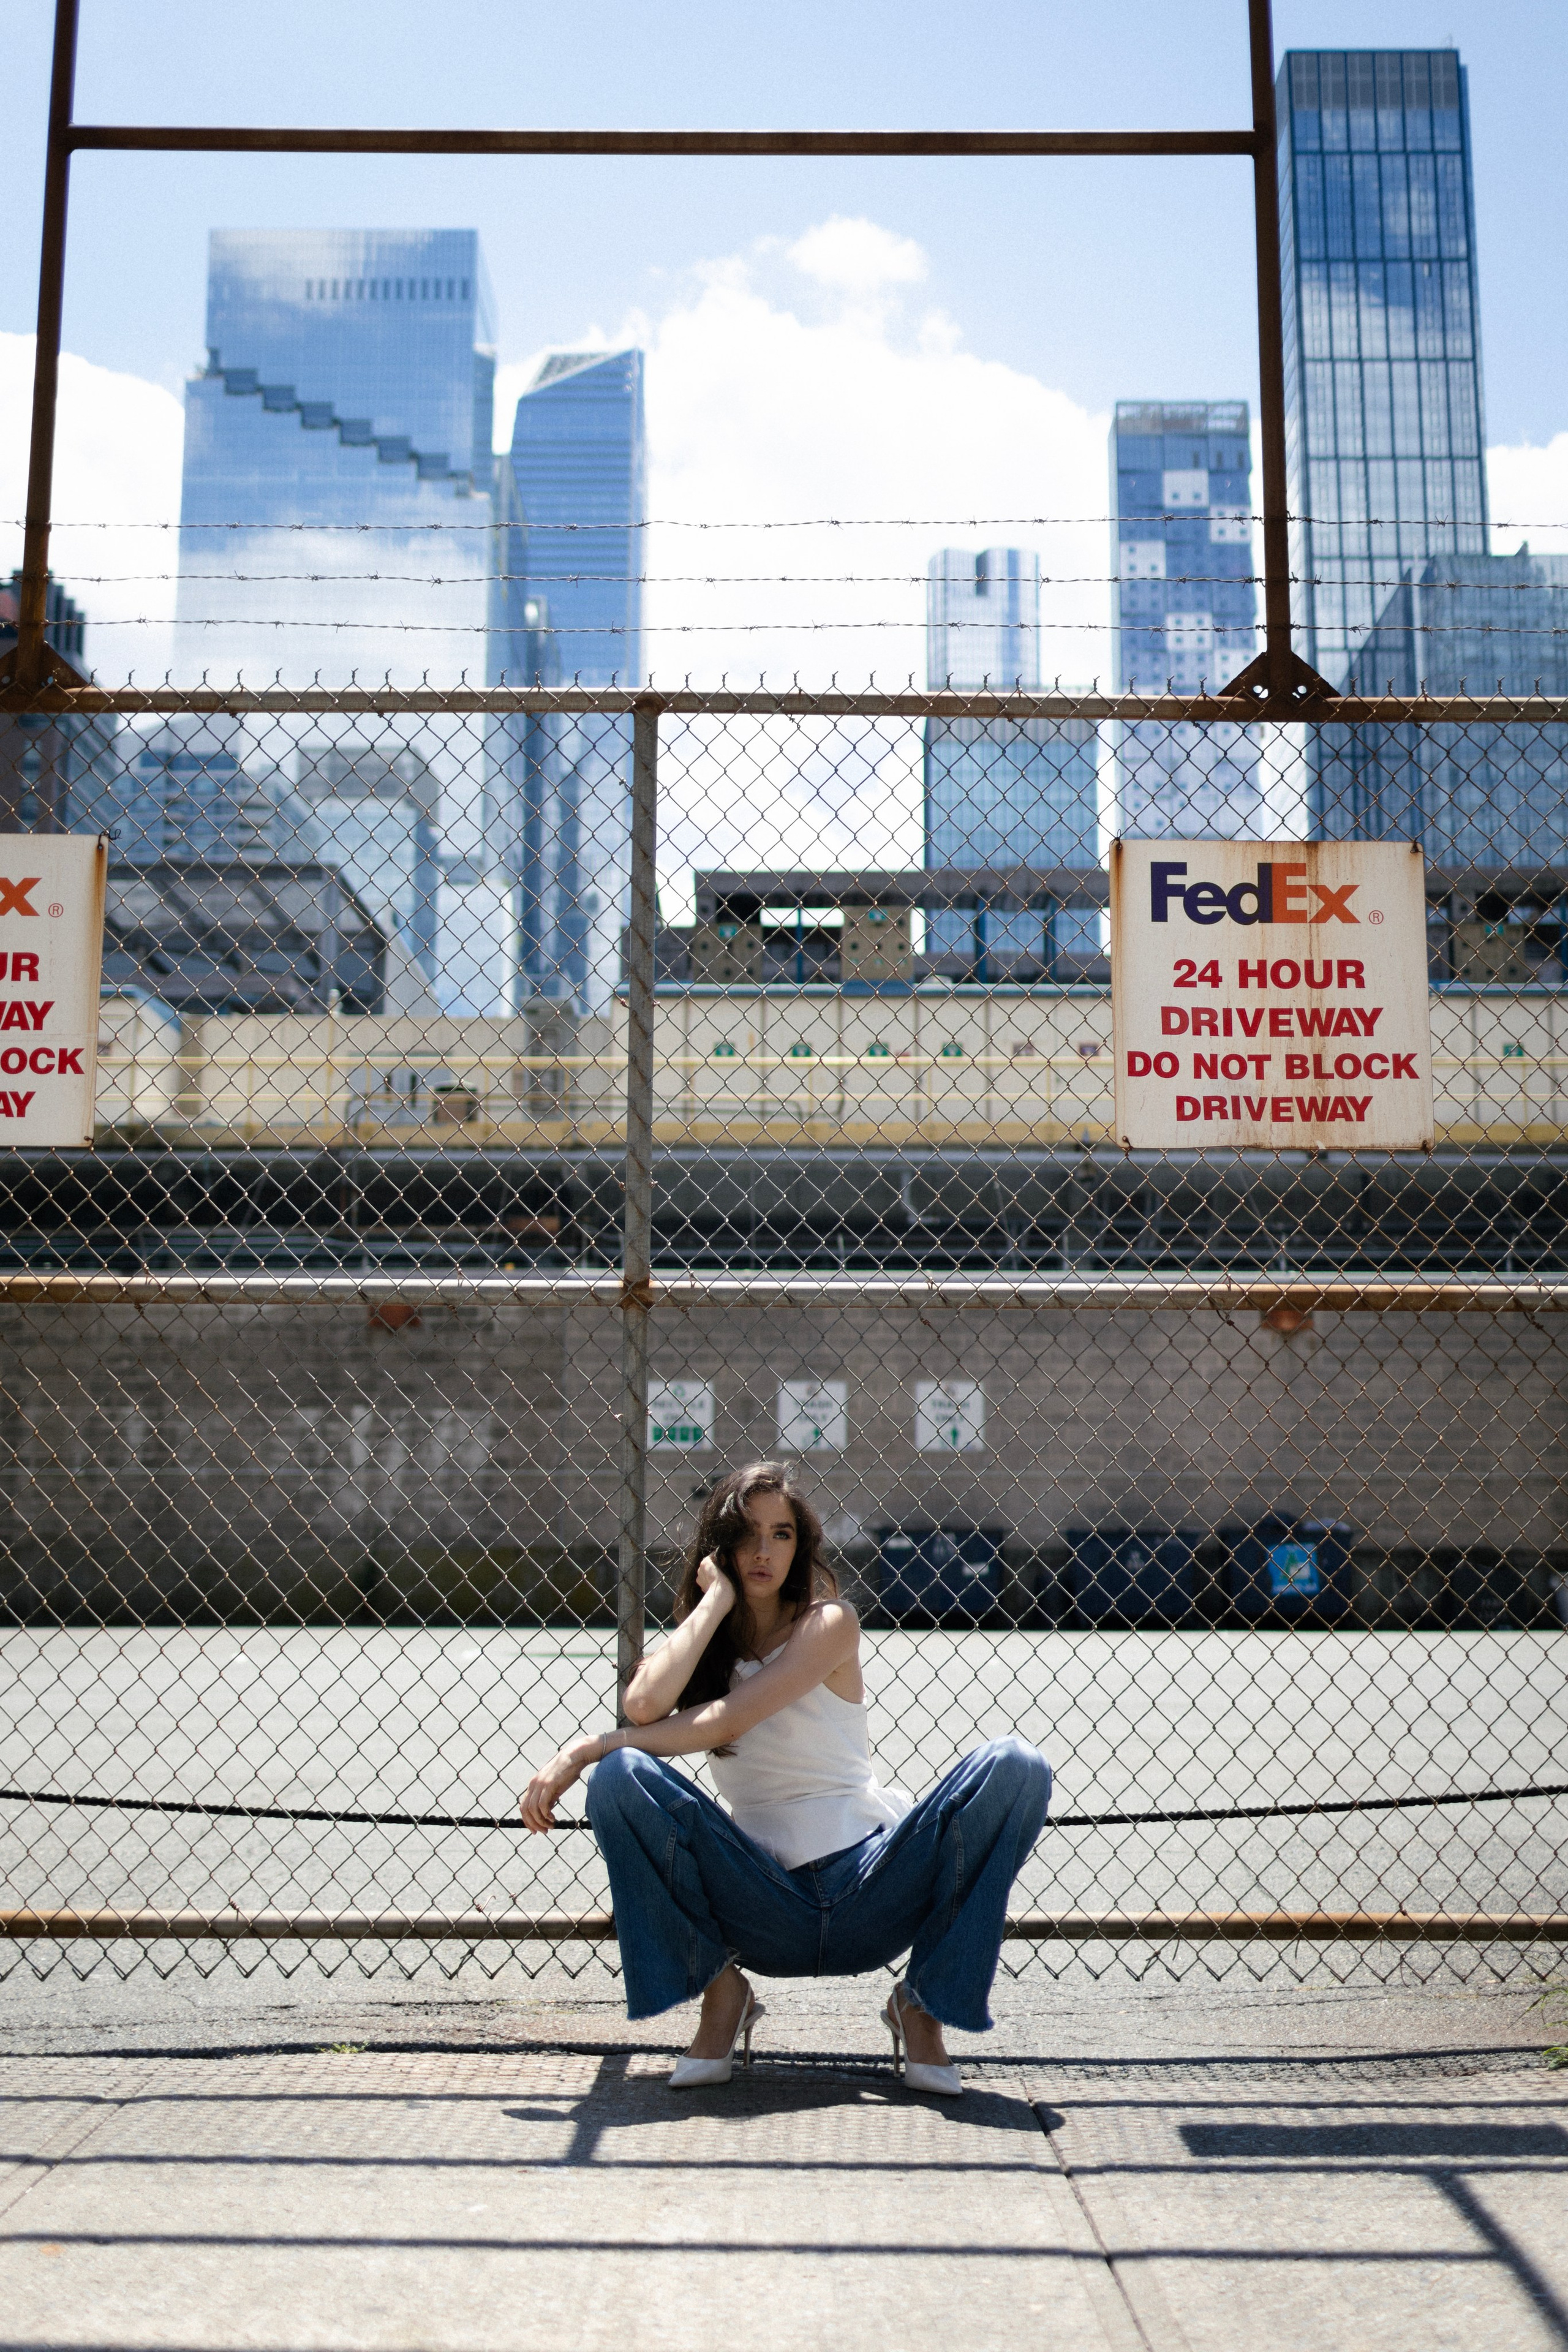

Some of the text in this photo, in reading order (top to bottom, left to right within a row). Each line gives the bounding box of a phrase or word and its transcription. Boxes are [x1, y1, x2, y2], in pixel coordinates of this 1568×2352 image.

[1150, 861, 1361, 925] FedEx
[1173, 959, 1365, 989] 24 HOUR
[1160, 1006, 1384, 1038] DRIVEWAY
[1127, 1050, 1420, 1080] DO NOT BLOCK
[1176, 1095, 1373, 1123] DRIVEWAY
